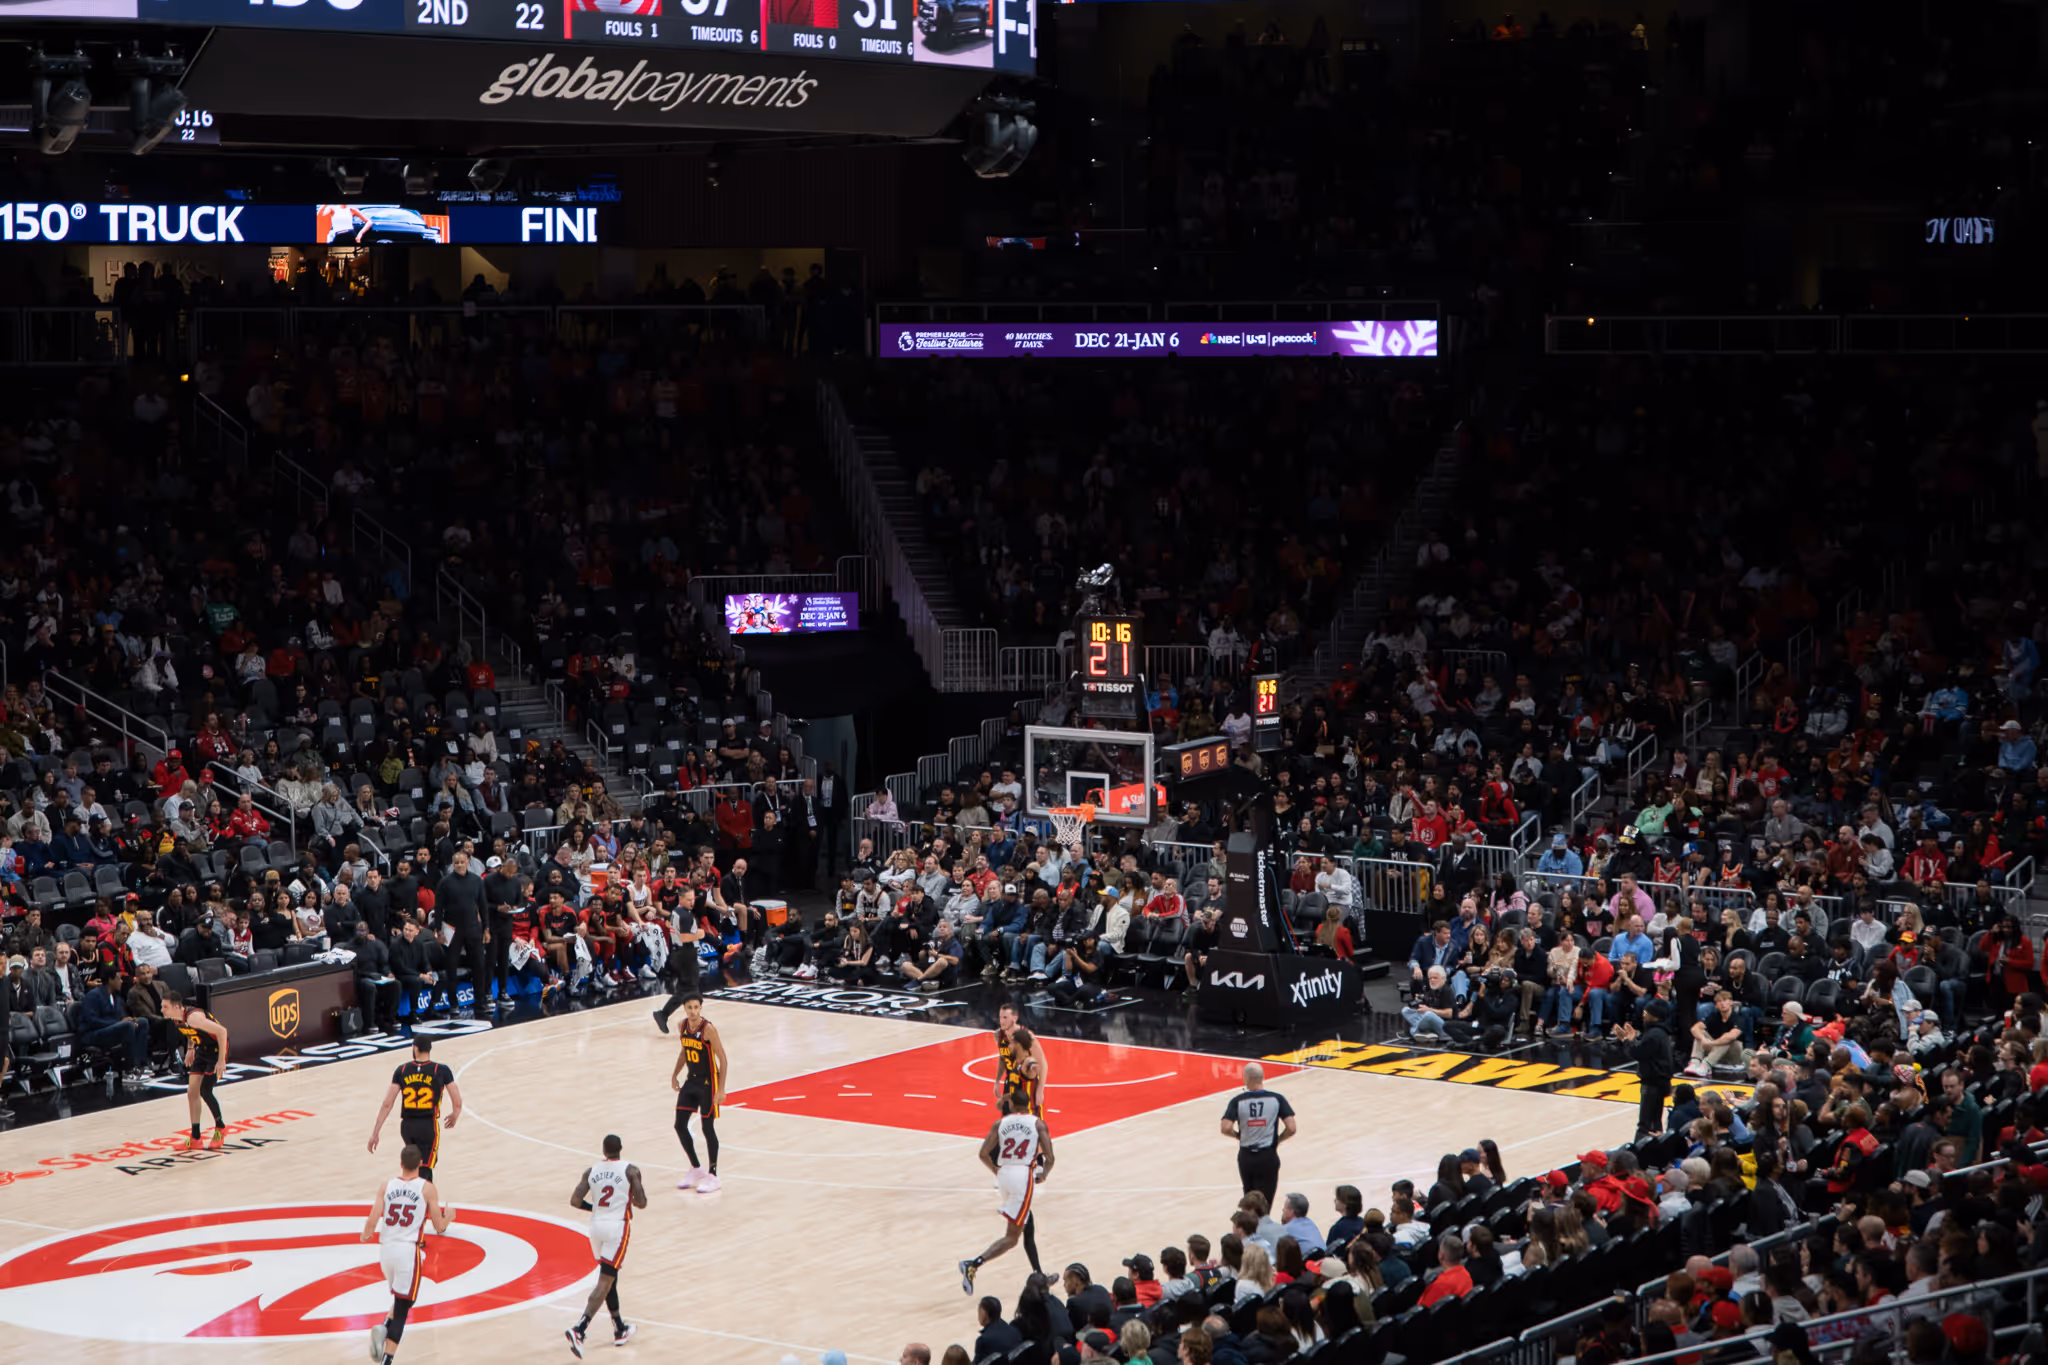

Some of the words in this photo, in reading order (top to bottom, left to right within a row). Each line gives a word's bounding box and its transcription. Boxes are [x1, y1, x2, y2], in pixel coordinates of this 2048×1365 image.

[417, 0, 468, 25] 2ND
[515, 3, 545, 30] 22
[605, 20, 643, 38] FOULS
[651, 22, 659, 38] 1
[691, 25, 743, 43] TIMEOUTS
[750, 29, 758, 45] 6
[793, 33, 824, 49] FOULS
[829, 35, 837, 49] 0
[861, 38, 904, 54] TIMEOUTS
[906, 41, 913, 56] 6
[181, 129, 195, 140] 22
[100, 205, 244, 241] TRUCK
[1074, 332, 1110, 348] DEC
[1169, 332, 1180, 348] 6
[1217, 335, 1241, 344] NBC
[1272, 332, 1314, 347] peacock
[800, 612, 816, 620] DEC
[841, 611, 847, 619] 6
[1089, 641, 1128, 676] 21
[1259, 694, 1273, 713] 21
[1257, 850, 1269, 928] ticketmaster
[724, 981, 968, 1013] EMORY
[1290, 968, 1342, 1007] xfinity
[272, 1002, 297, 1031] ups
[681, 1037, 703, 1050] HAWKS
[686, 1049, 700, 1063] 10
[404, 1073, 424, 1085] NANCE
[402, 1086, 434, 1109] 22
[1249, 1101, 1264, 1117] 67
[115, 1138, 288, 1175] ARENA
[1001, 1138, 1030, 1159] 24
[591, 1171, 614, 1184] ROZIER
[387, 1189, 420, 1203] ROBINSON
[598, 1185, 614, 1207] 2
[385, 1204, 417, 1227] 55
